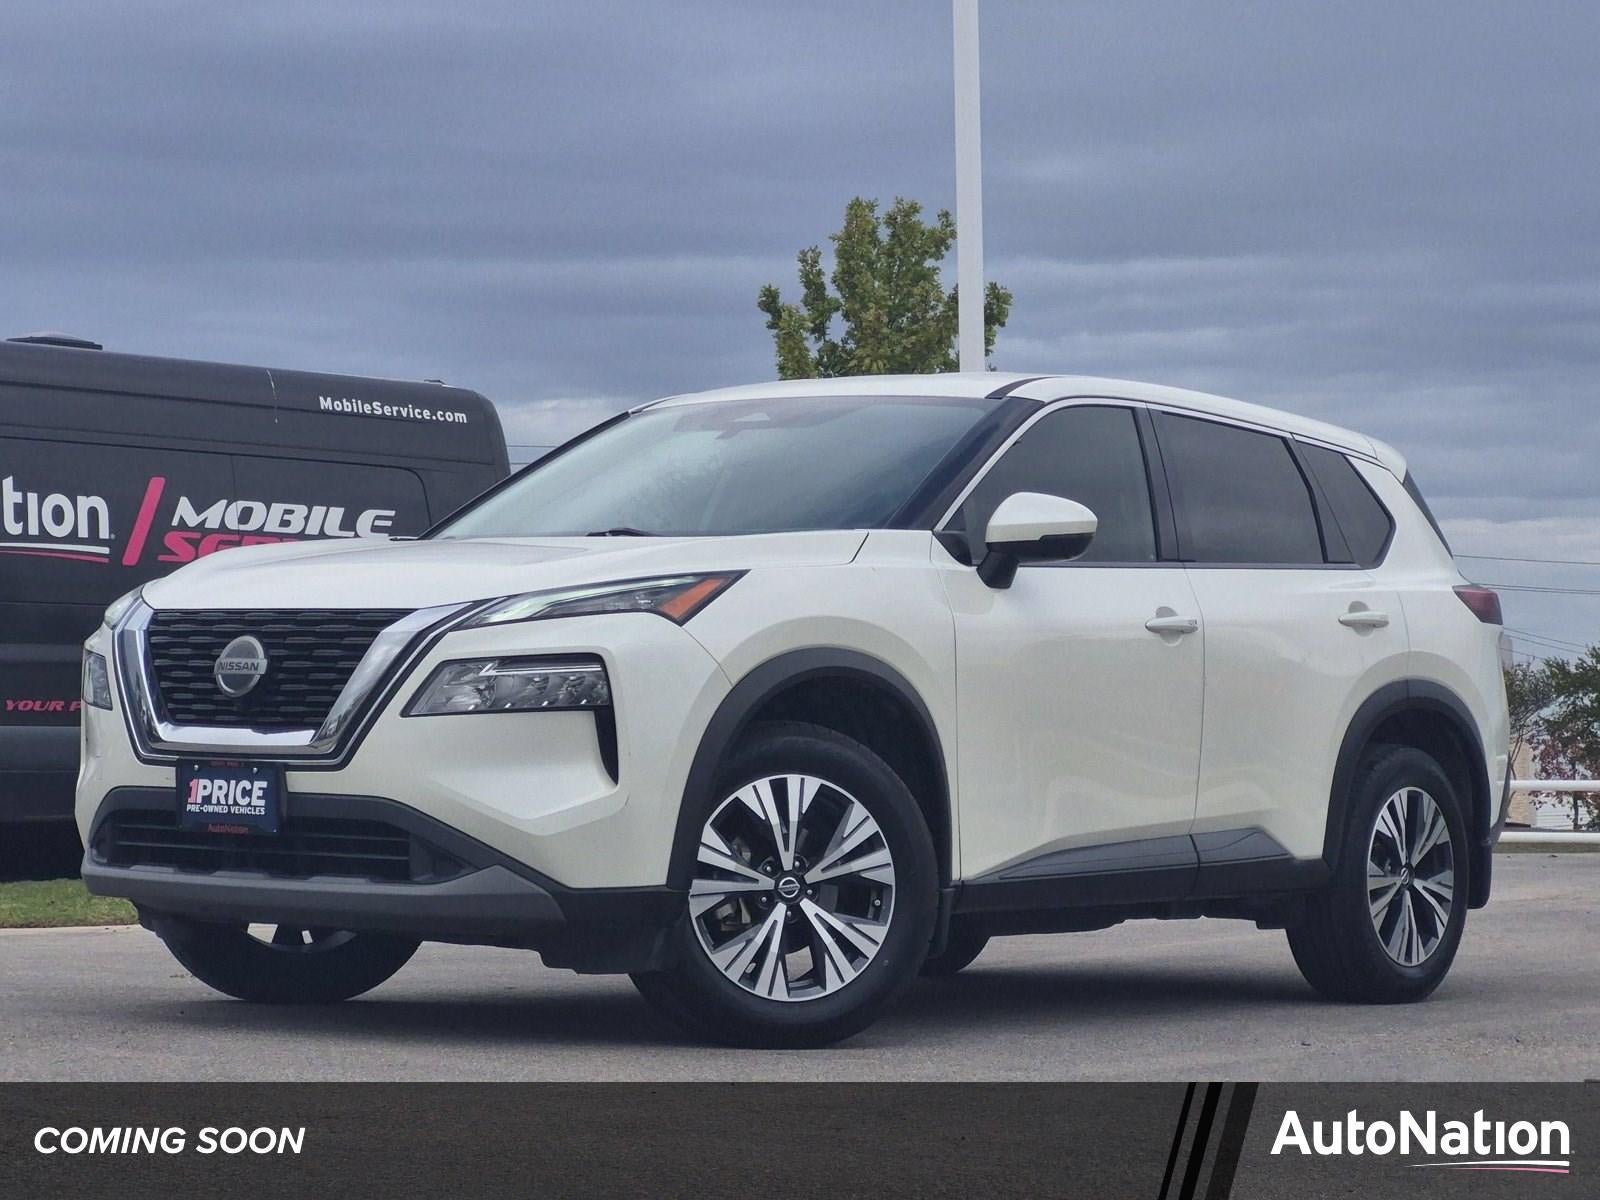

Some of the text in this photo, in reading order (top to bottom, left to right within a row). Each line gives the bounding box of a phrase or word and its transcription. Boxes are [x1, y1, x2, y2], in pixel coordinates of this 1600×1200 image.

[319, 396, 467, 423] MobileService.com
[171, 496, 396, 538] MOBILE
[220, 661, 259, 671] NISSAN
[6, 699, 65, 712] YOUR
[186, 804, 265, 815] PRE-OWNED VEHICLES
